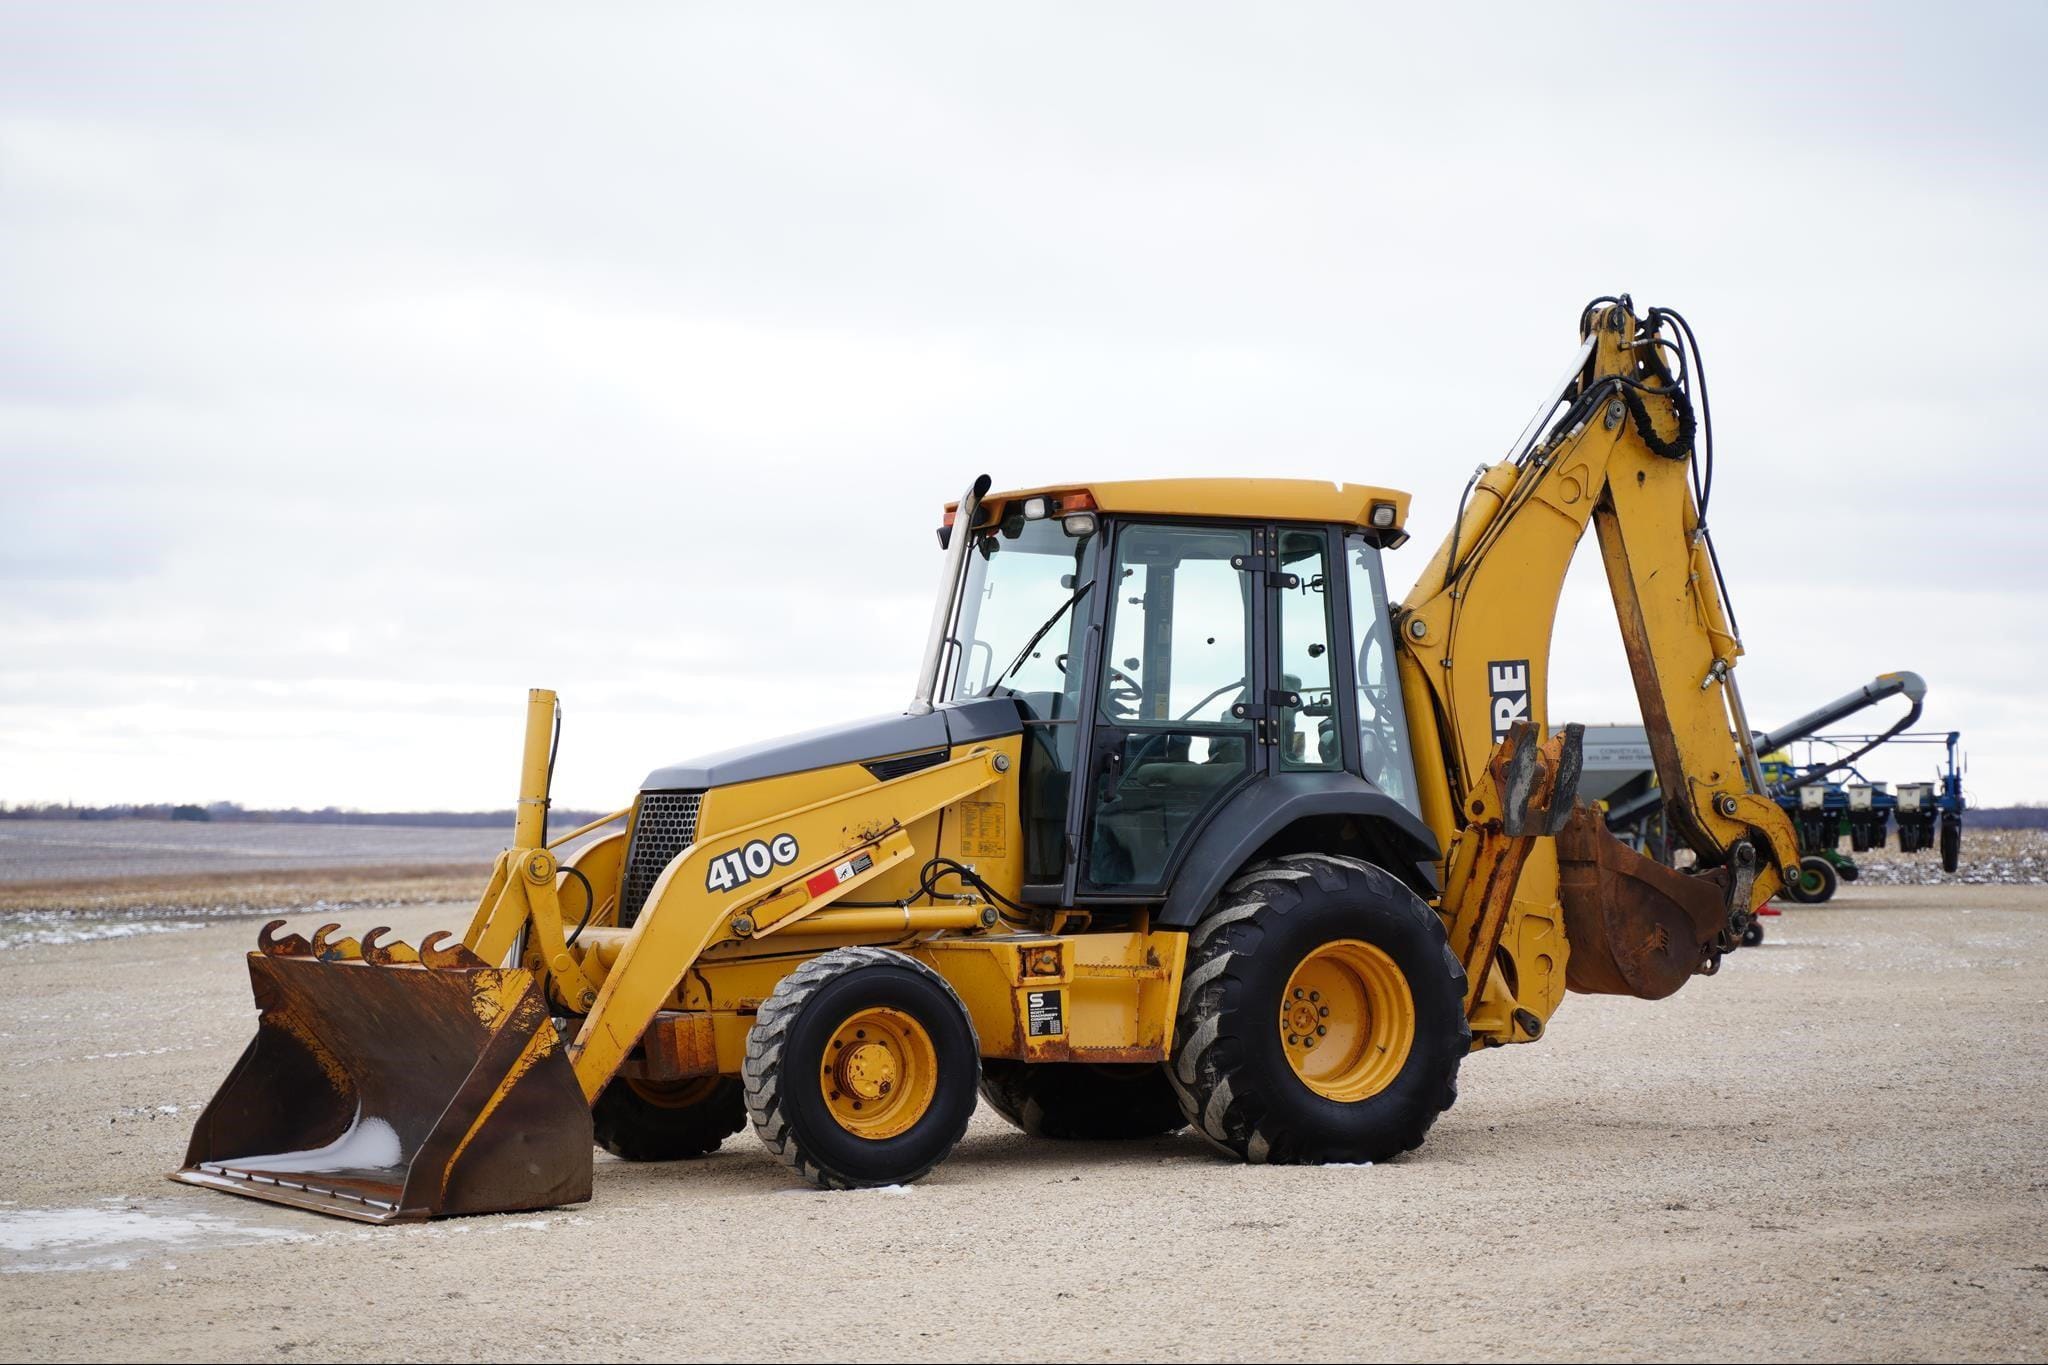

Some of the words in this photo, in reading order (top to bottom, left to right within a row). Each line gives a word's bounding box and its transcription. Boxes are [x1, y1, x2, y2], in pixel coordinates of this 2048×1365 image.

[1491, 664, 1528, 744] RE
[707, 835, 798, 890] 410G
[1030, 993, 1044, 1008] S
